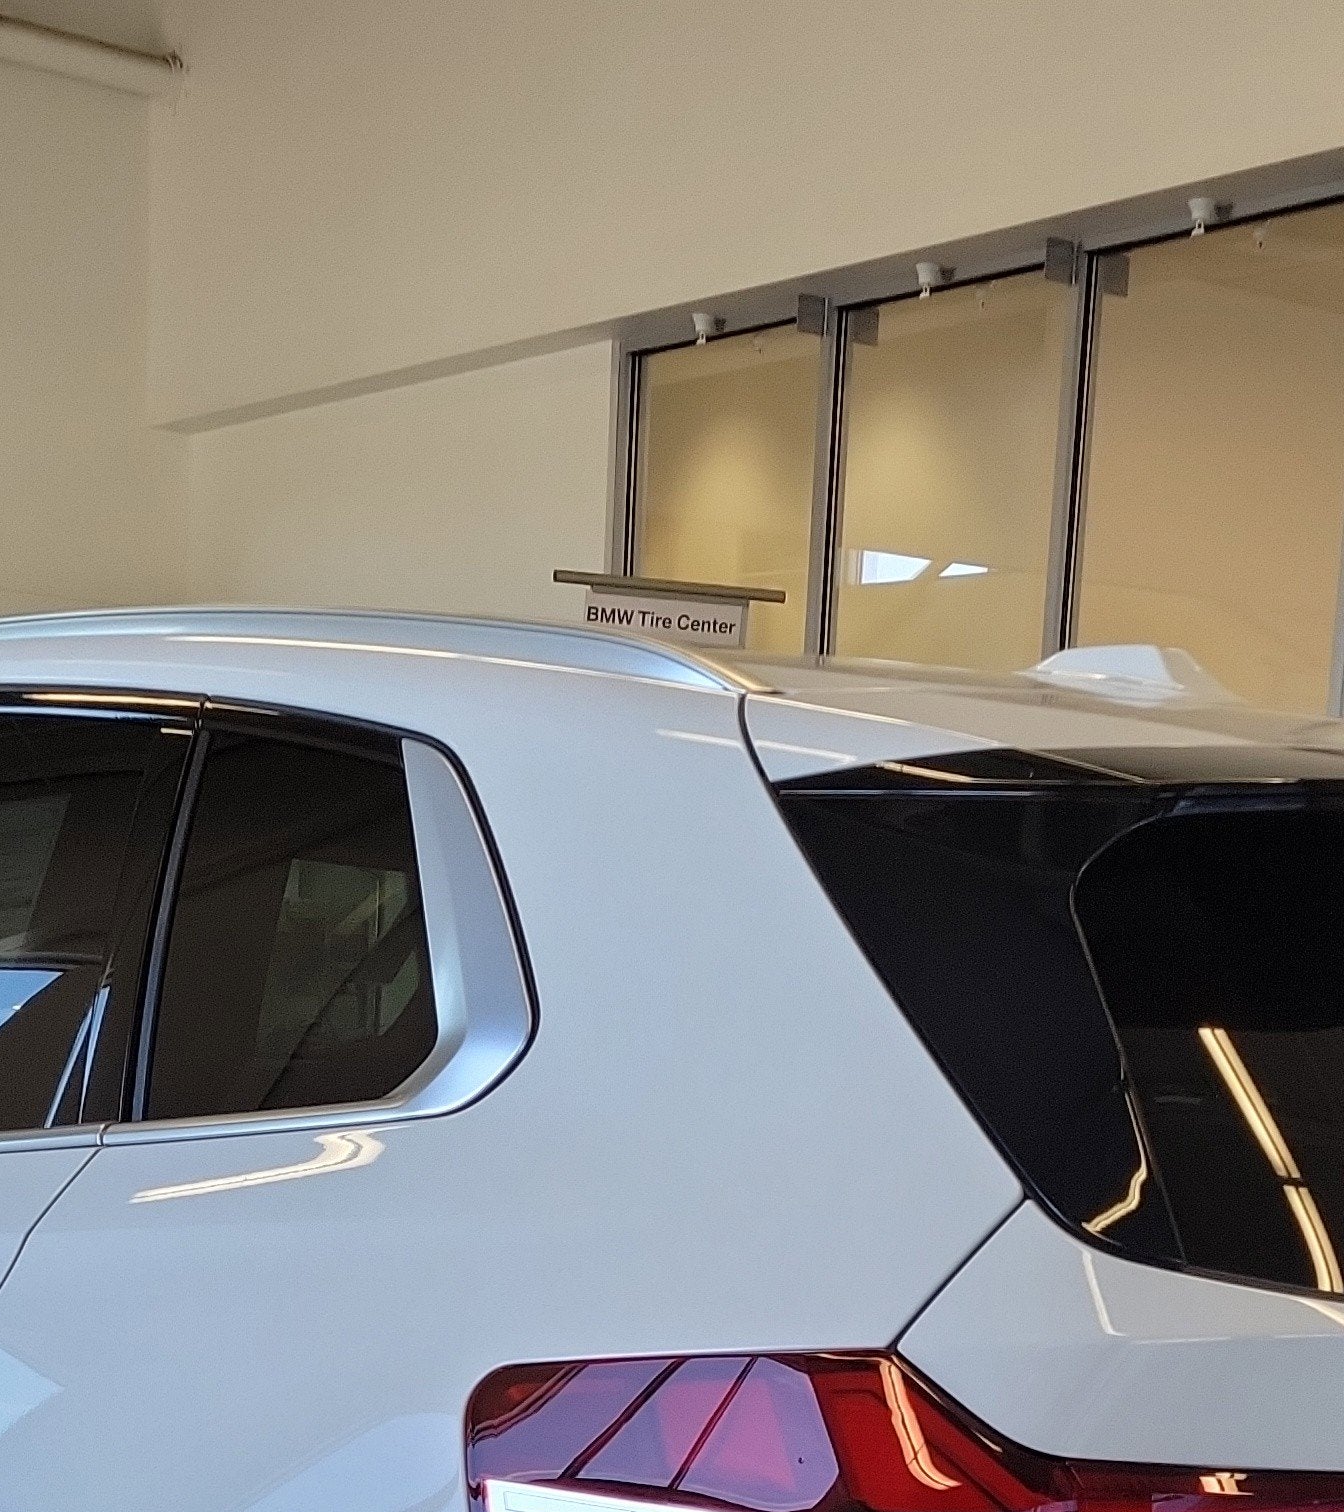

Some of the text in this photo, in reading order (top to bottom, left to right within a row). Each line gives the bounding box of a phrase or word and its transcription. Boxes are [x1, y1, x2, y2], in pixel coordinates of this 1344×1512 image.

[586, 605, 737, 635] BMW Tire Center
